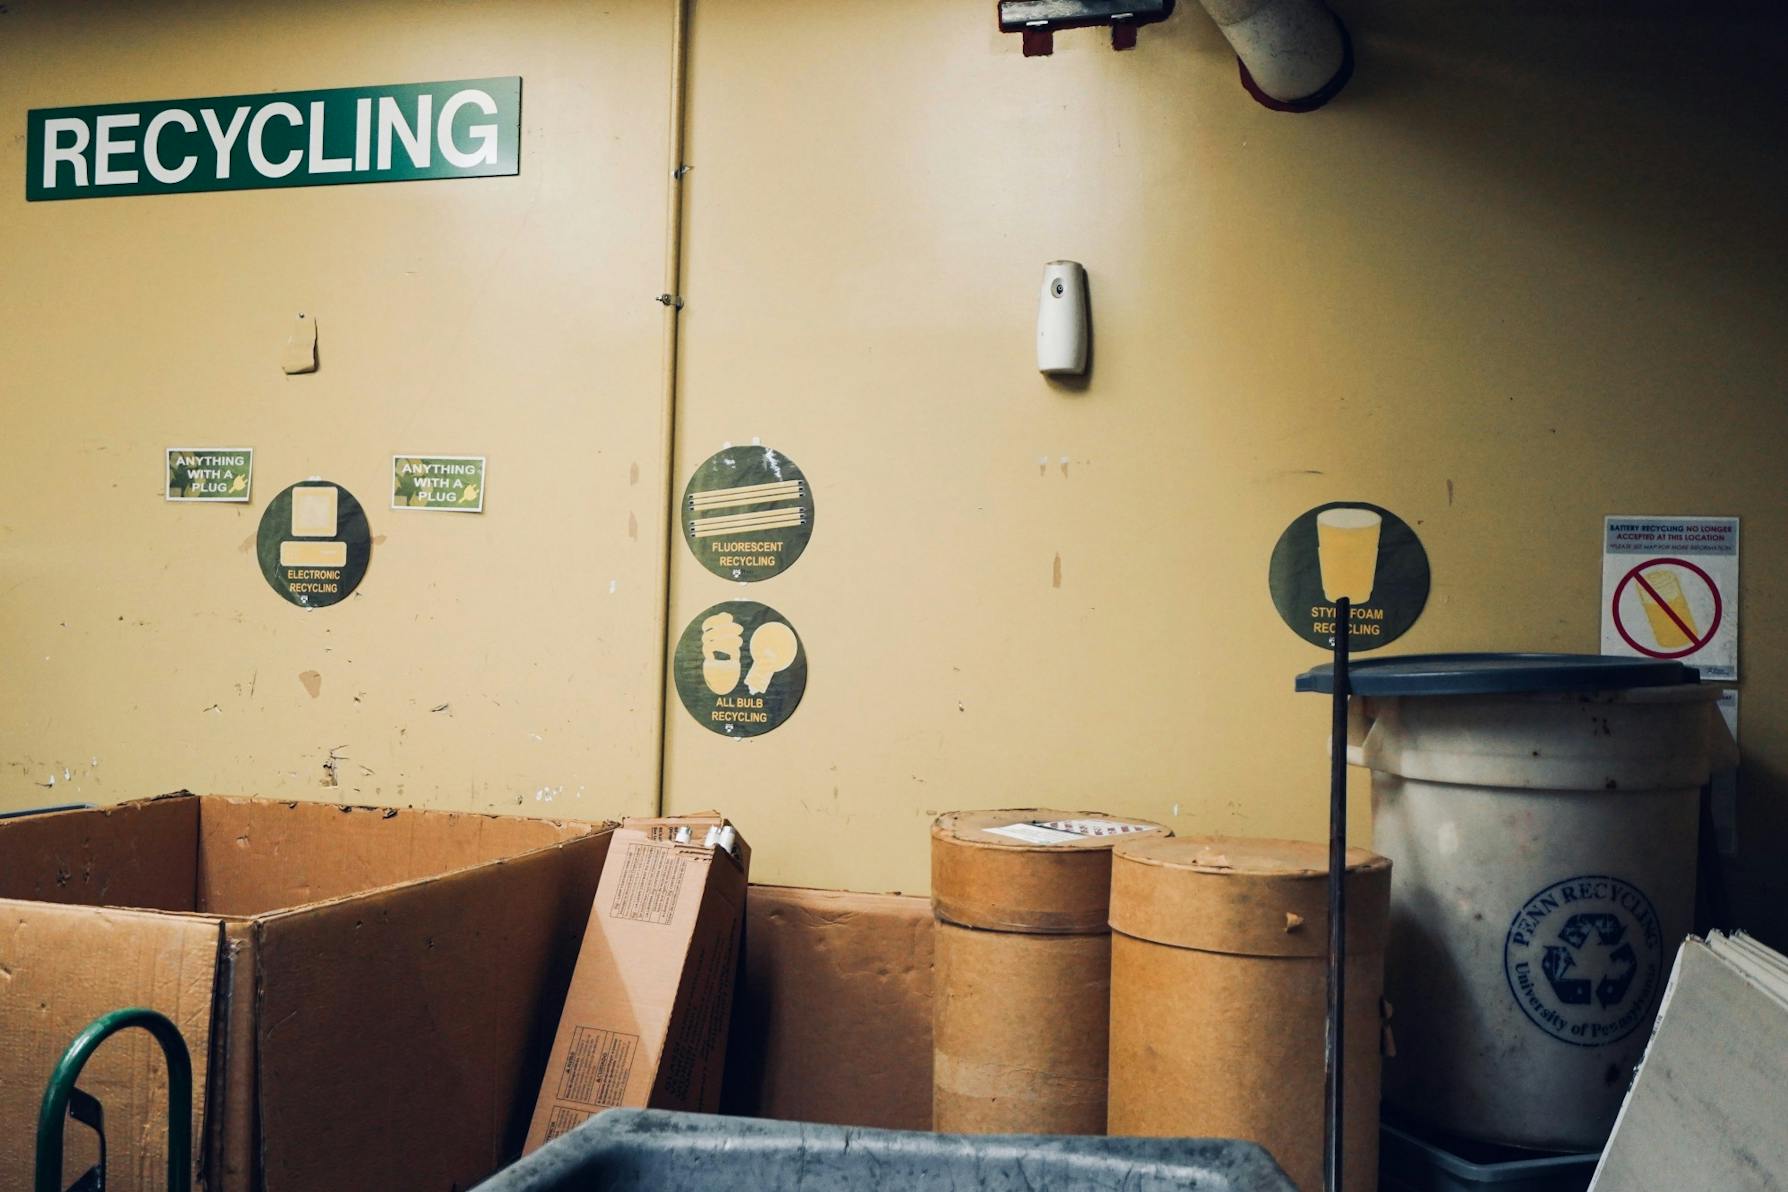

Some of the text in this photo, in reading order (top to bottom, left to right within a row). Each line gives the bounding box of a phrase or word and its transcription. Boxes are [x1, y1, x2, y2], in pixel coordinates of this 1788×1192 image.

[43, 89, 498, 188] RECYCLING
[176, 456, 245, 466] ANYTHING
[187, 469, 233, 479] WITH A
[402, 463, 476, 475] ANYTHING
[192, 483, 227, 492] PLUG
[414, 477, 463, 488] WITH A
[418, 491, 457, 502] PLUG
[712, 542, 783, 552] FLUORESCENT
[719, 556, 775, 566] RECYCLING
[288, 569, 341, 579] ELECTRONIC
[289, 583, 338, 593] RECYCLING
[1311, 607, 1384, 619] STYFOAM
[1313, 622, 1380, 635] RECLING
[716, 697, 764, 708] ALL BULB
[711, 711, 768, 722] RECYCLING
[1513, 882, 1658, 950] PENN RECYCLING
[1515, 962, 1568, 1031] University
[1571, 1023, 1588, 1036] of
